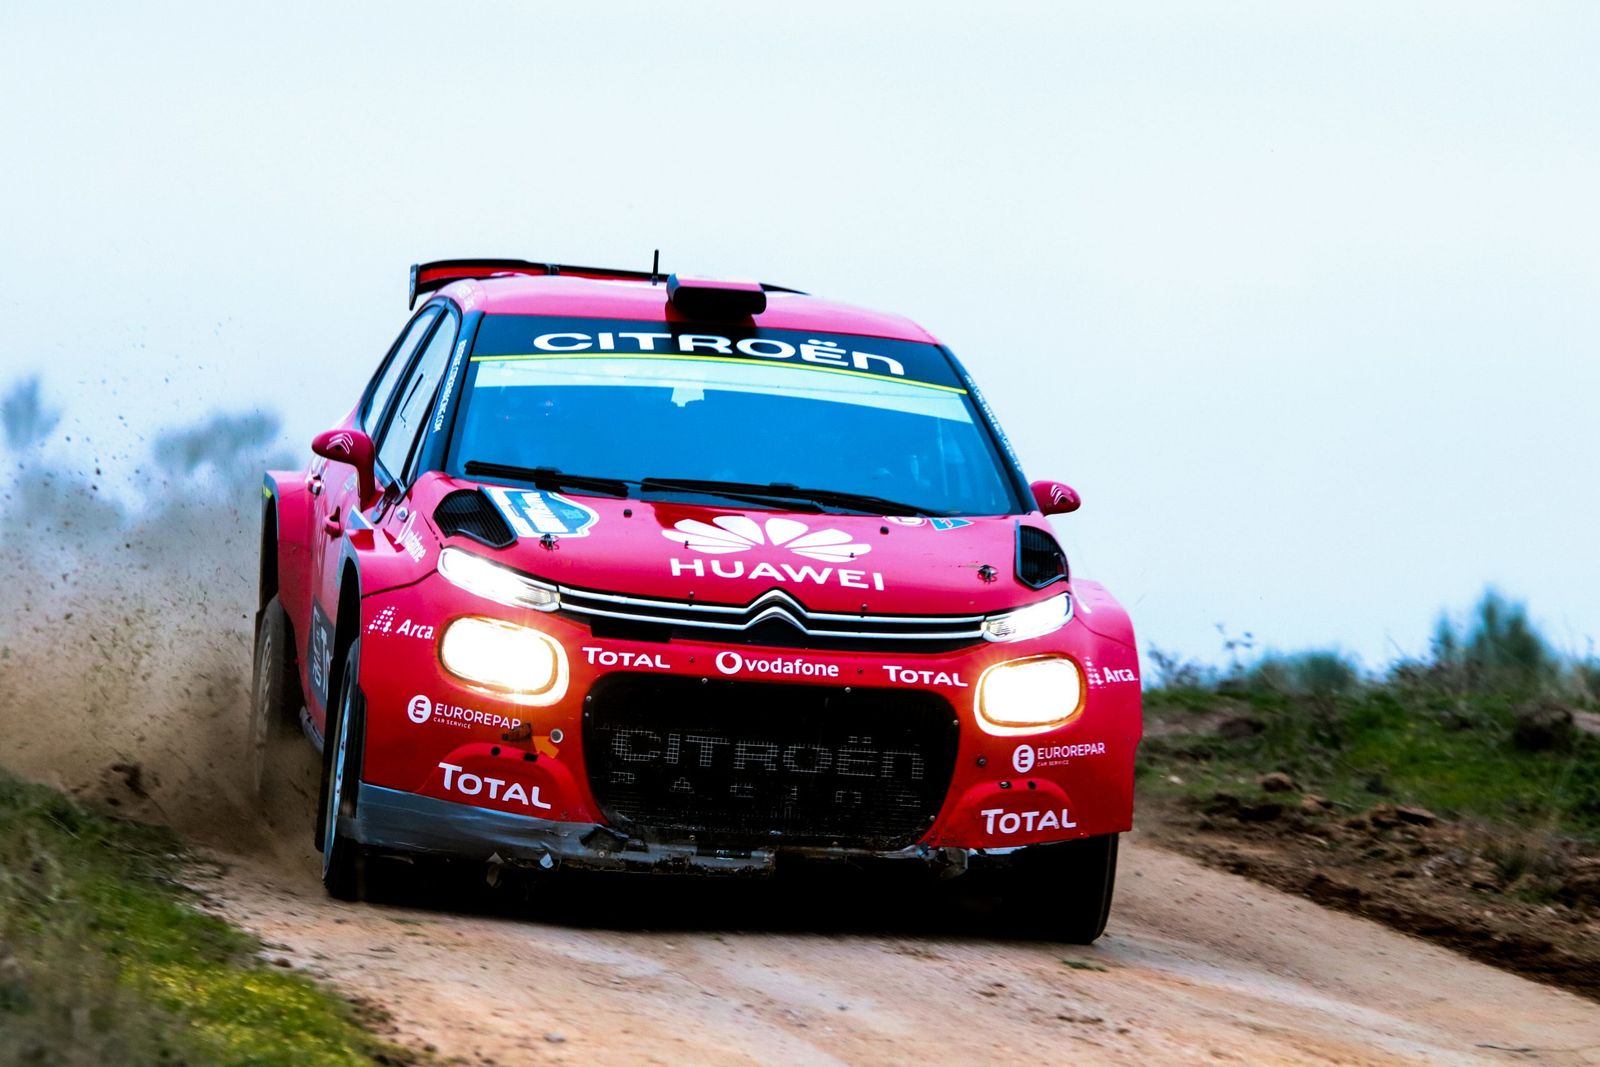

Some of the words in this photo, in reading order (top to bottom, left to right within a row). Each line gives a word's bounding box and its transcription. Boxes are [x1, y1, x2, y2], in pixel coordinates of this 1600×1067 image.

[670, 558, 885, 591] HUAWEI
[582, 646, 671, 668] TOTAL
[744, 657, 840, 677] vodafone
[882, 665, 969, 687] TOTAL
[446, 720, 472, 729] SERVICE
[1037, 742, 1106, 760] EUROREPAR
[438, 762, 552, 810] TOTAL
[980, 808, 1077, 834] TOTAL
